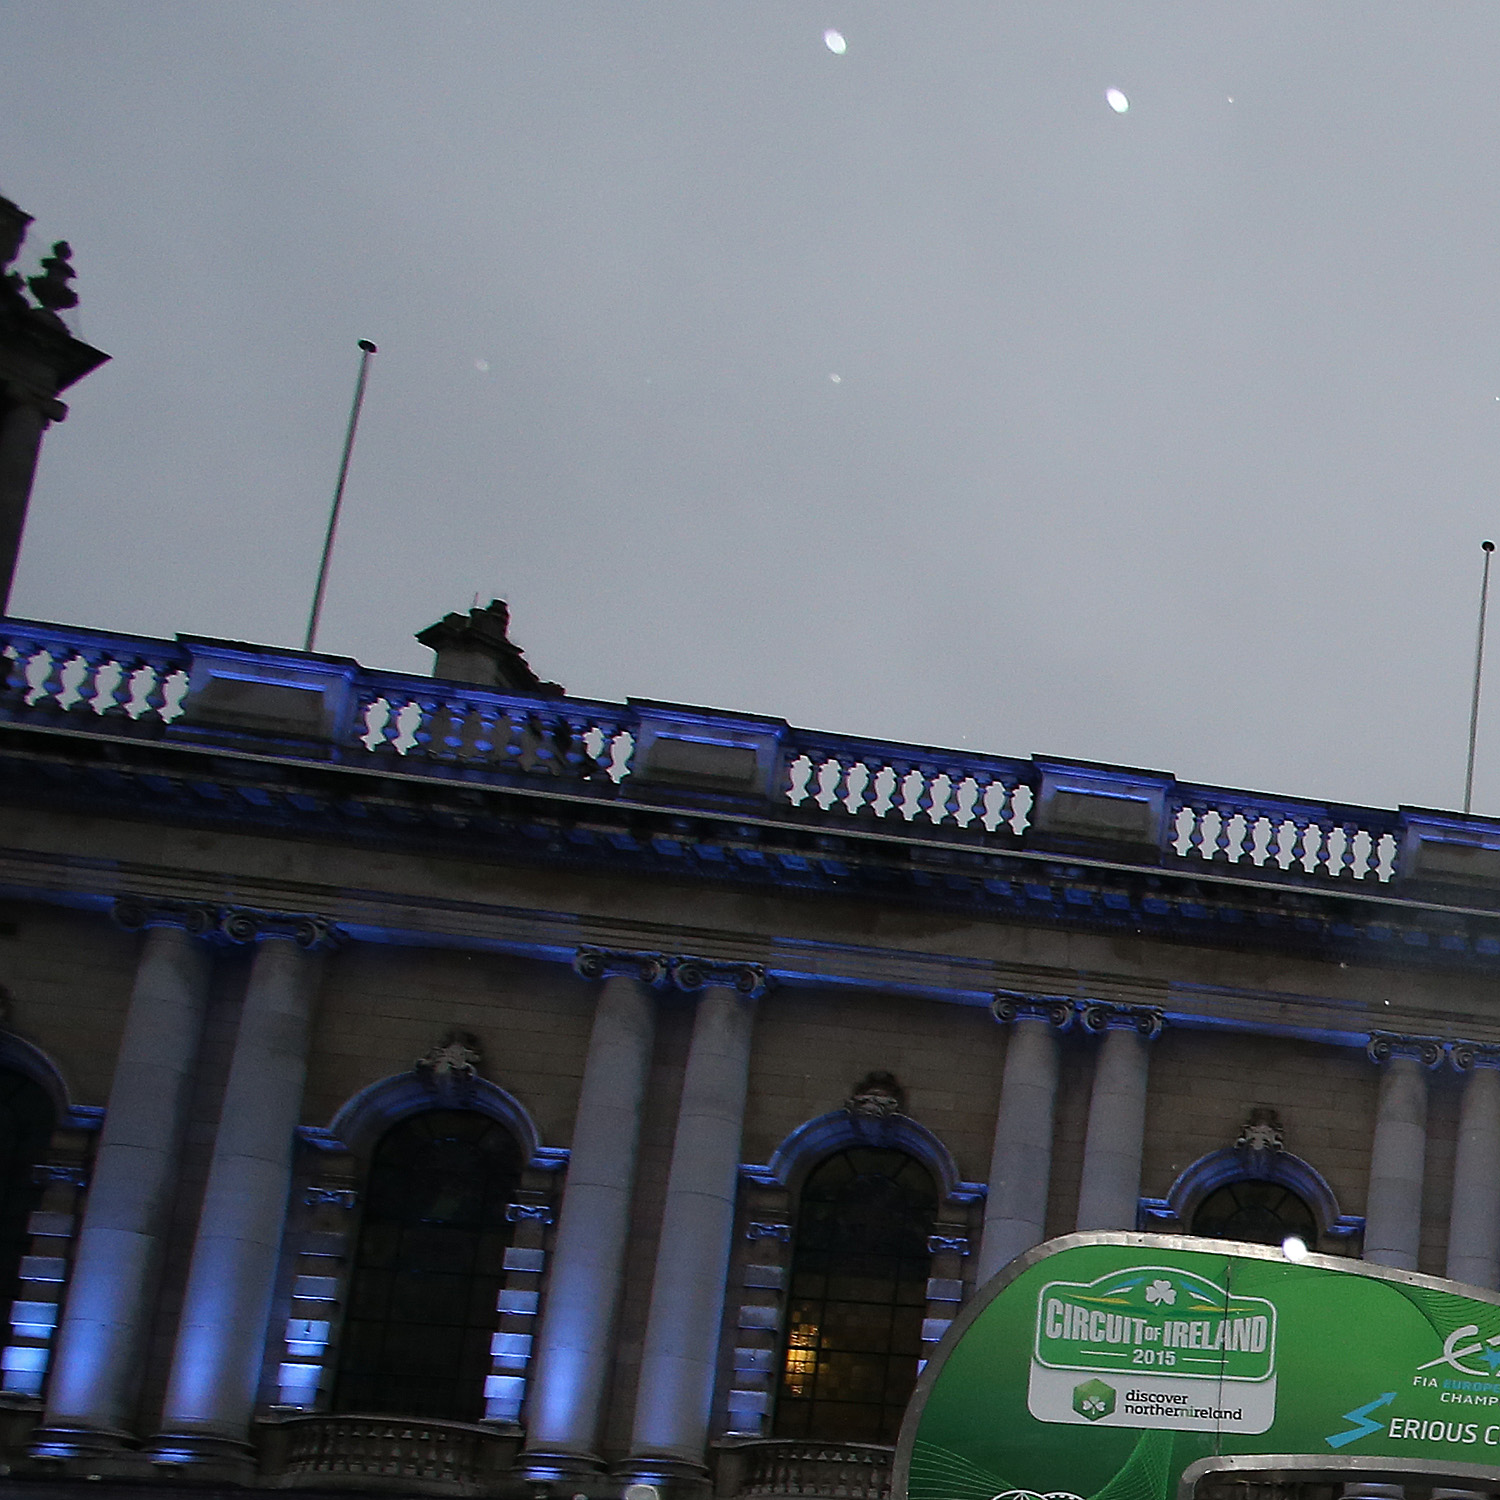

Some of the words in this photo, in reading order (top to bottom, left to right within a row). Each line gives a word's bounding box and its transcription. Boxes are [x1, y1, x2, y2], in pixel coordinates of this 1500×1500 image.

[1045, 1298, 1147, 1345] CIRCUIT
[1163, 1315, 1268, 1353] IRELAND
[1132, 1349, 1176, 1366] 2015
[1413, 1376, 1438, 1389] FIA
[1125, 1390, 1188, 1406] discover
